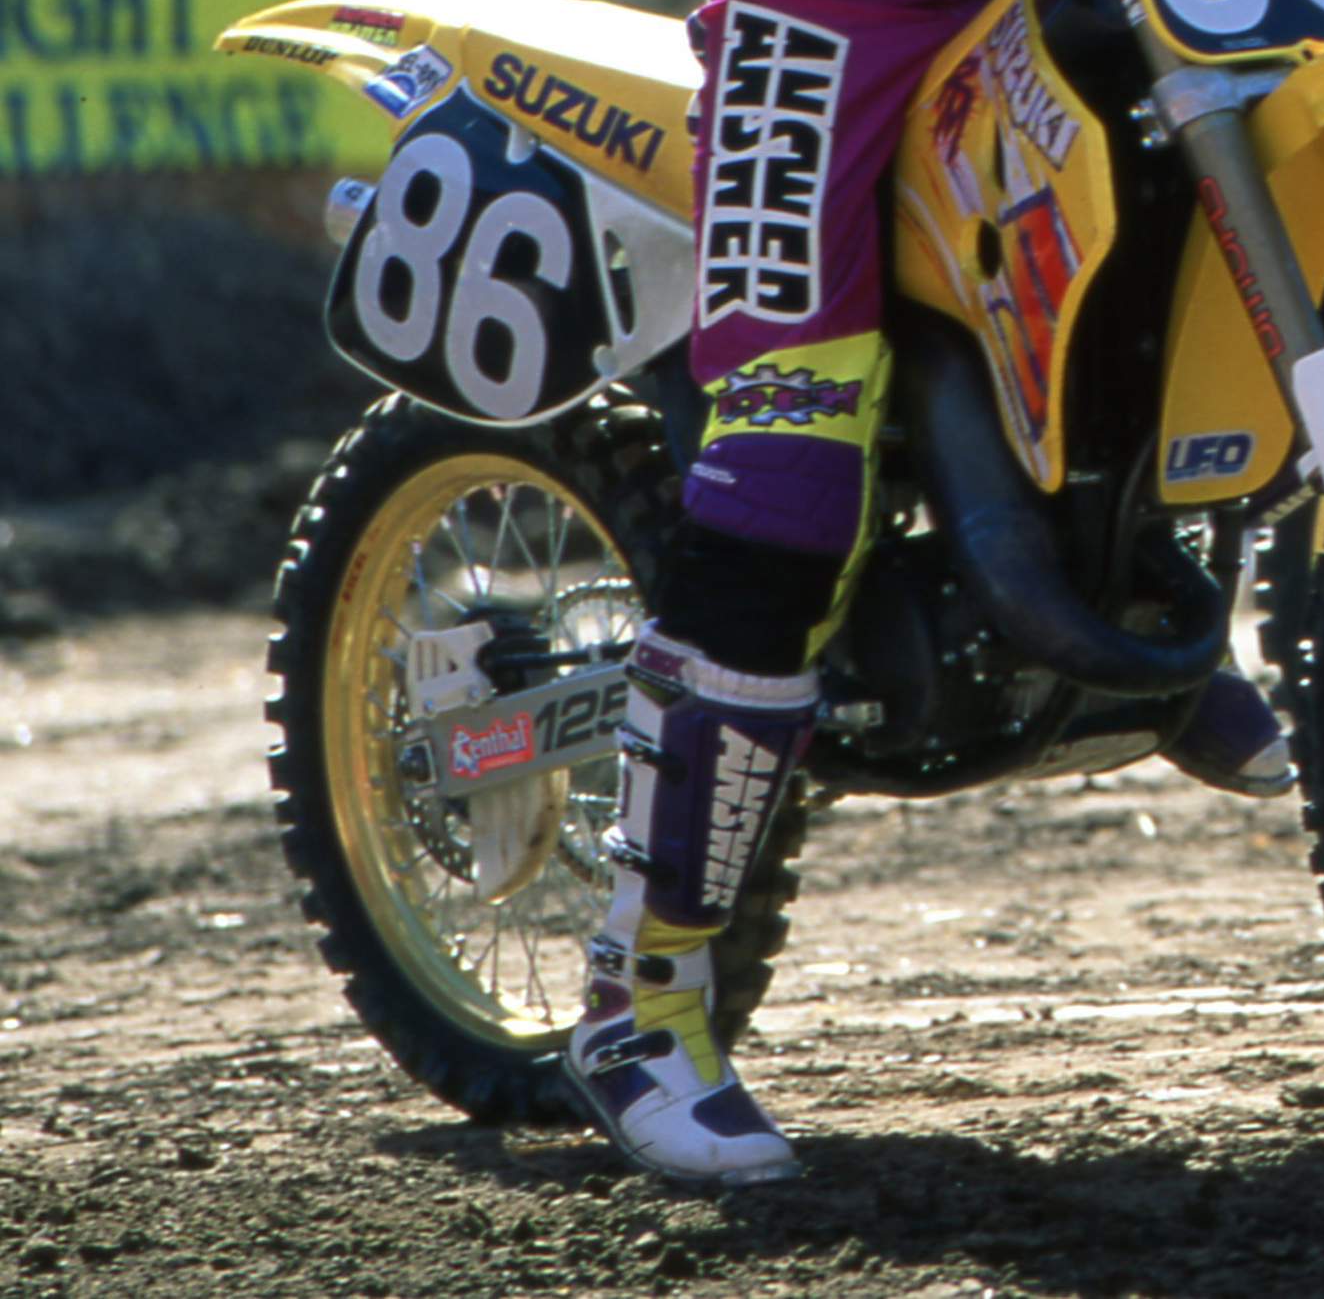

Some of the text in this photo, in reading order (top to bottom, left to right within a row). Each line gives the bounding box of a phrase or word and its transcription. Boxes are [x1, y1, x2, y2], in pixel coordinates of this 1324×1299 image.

[242, 36, 339, 66] DUNLOP
[484, 53, 664, 174] SUZUKI
[703, 1, 848, 328] ANSWER
[356, 133, 572, 420] 86
[1166, 432, 1255, 482] UFO
[452, 714, 530, 777] Renthal
[535, 682, 630, 753] 125
[701, 725, 778, 907] ANSWER
